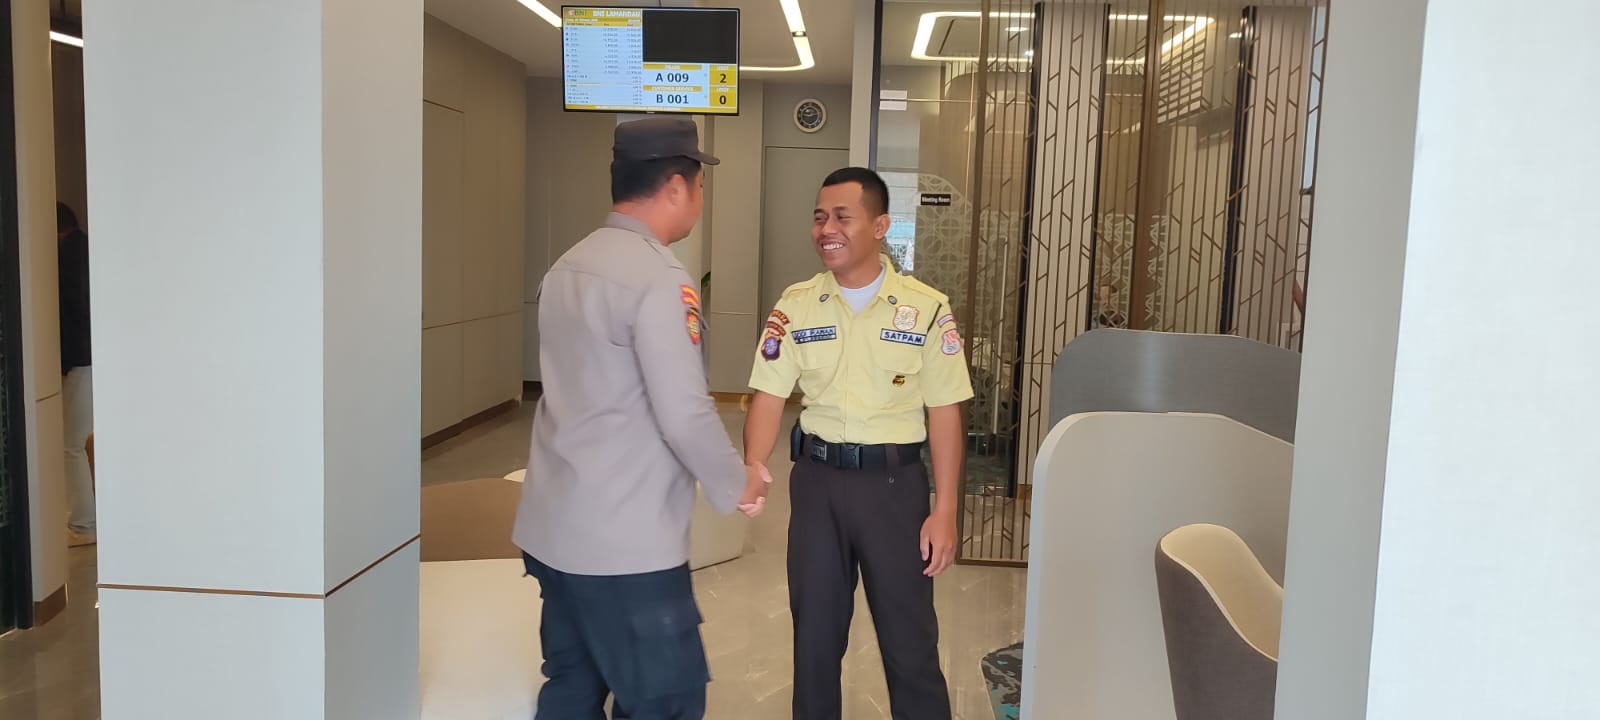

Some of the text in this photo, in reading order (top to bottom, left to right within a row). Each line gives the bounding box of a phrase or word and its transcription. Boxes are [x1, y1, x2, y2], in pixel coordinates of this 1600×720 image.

[655, 73, 690, 83] A 009
[719, 73, 727, 83] 2
[656, 94, 689, 104] B 001
[719, 95, 727, 105] 0
[921, 196, 938, 204] Meeting
[884, 331, 922, 343] SATPAM
